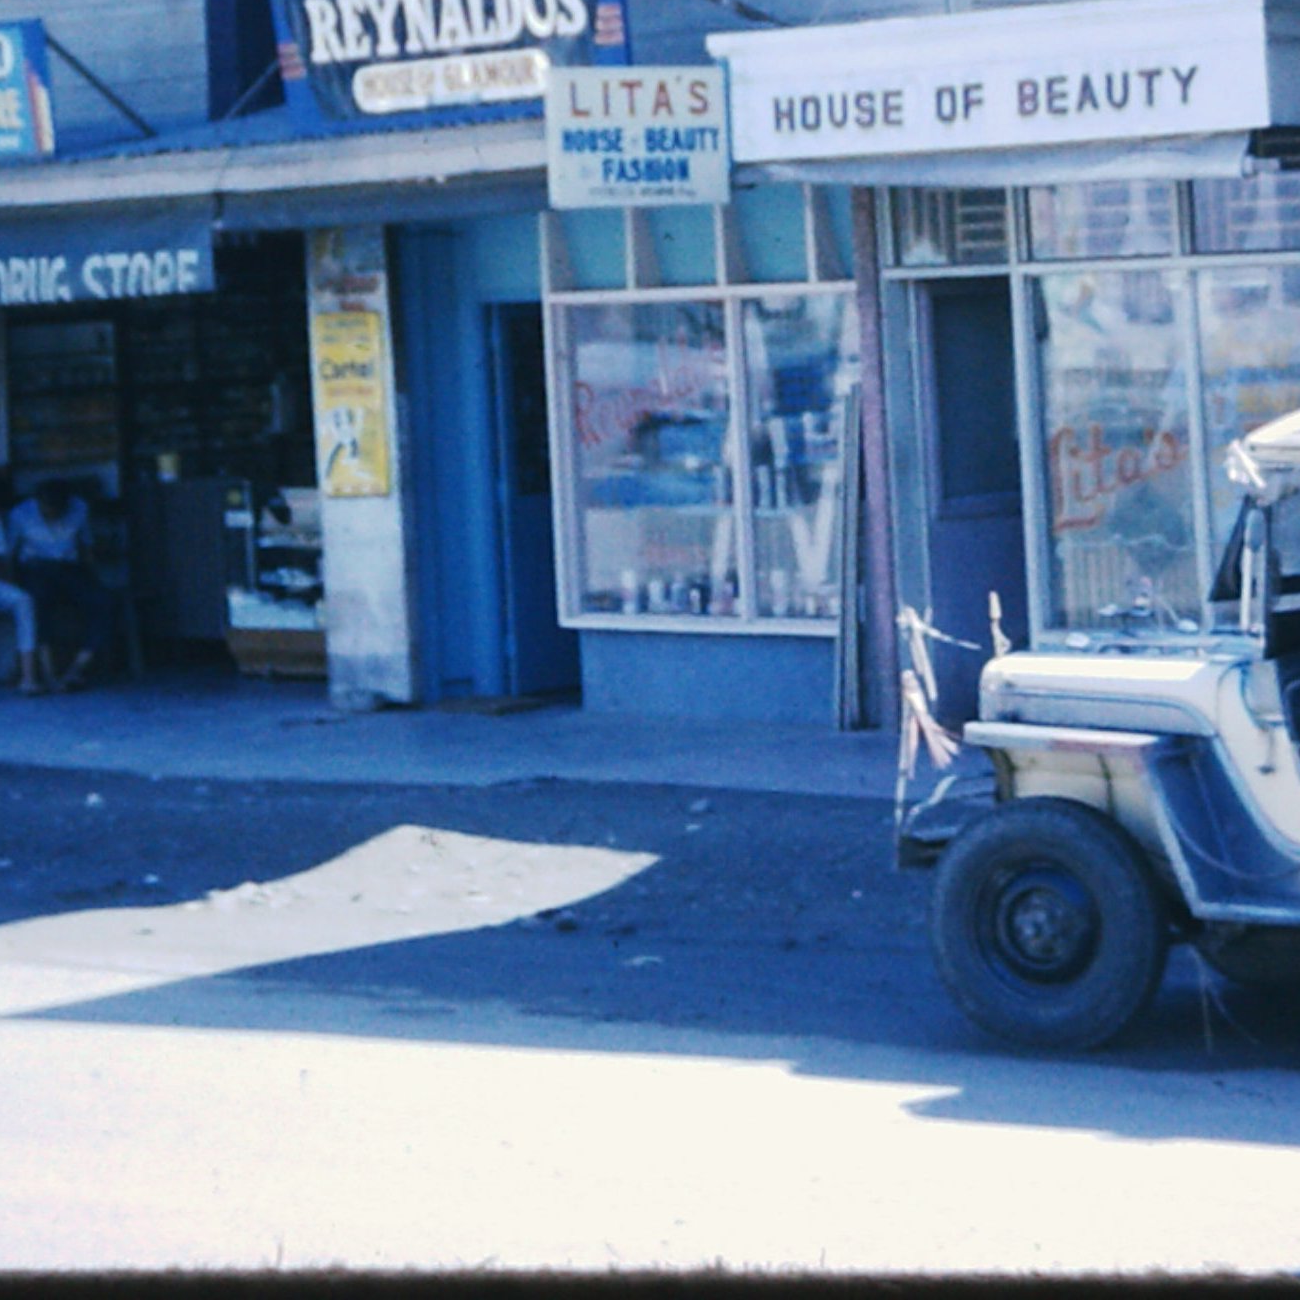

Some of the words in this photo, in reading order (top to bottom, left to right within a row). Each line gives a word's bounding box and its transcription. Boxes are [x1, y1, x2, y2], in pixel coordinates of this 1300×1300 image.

[569, 75, 710, 117] LITA'S
[773, 89, 903, 132] HOUSE
[935, 83, 984, 123] OF
[1017, 66, 1198, 118] BEAUTY
[562, 128, 623, 153] HOUSE
[645, 127, 719, 152] BEAUTY
[602, 158, 689, 182] FASHION
[1052, 425, 1182, 533] Lita's
